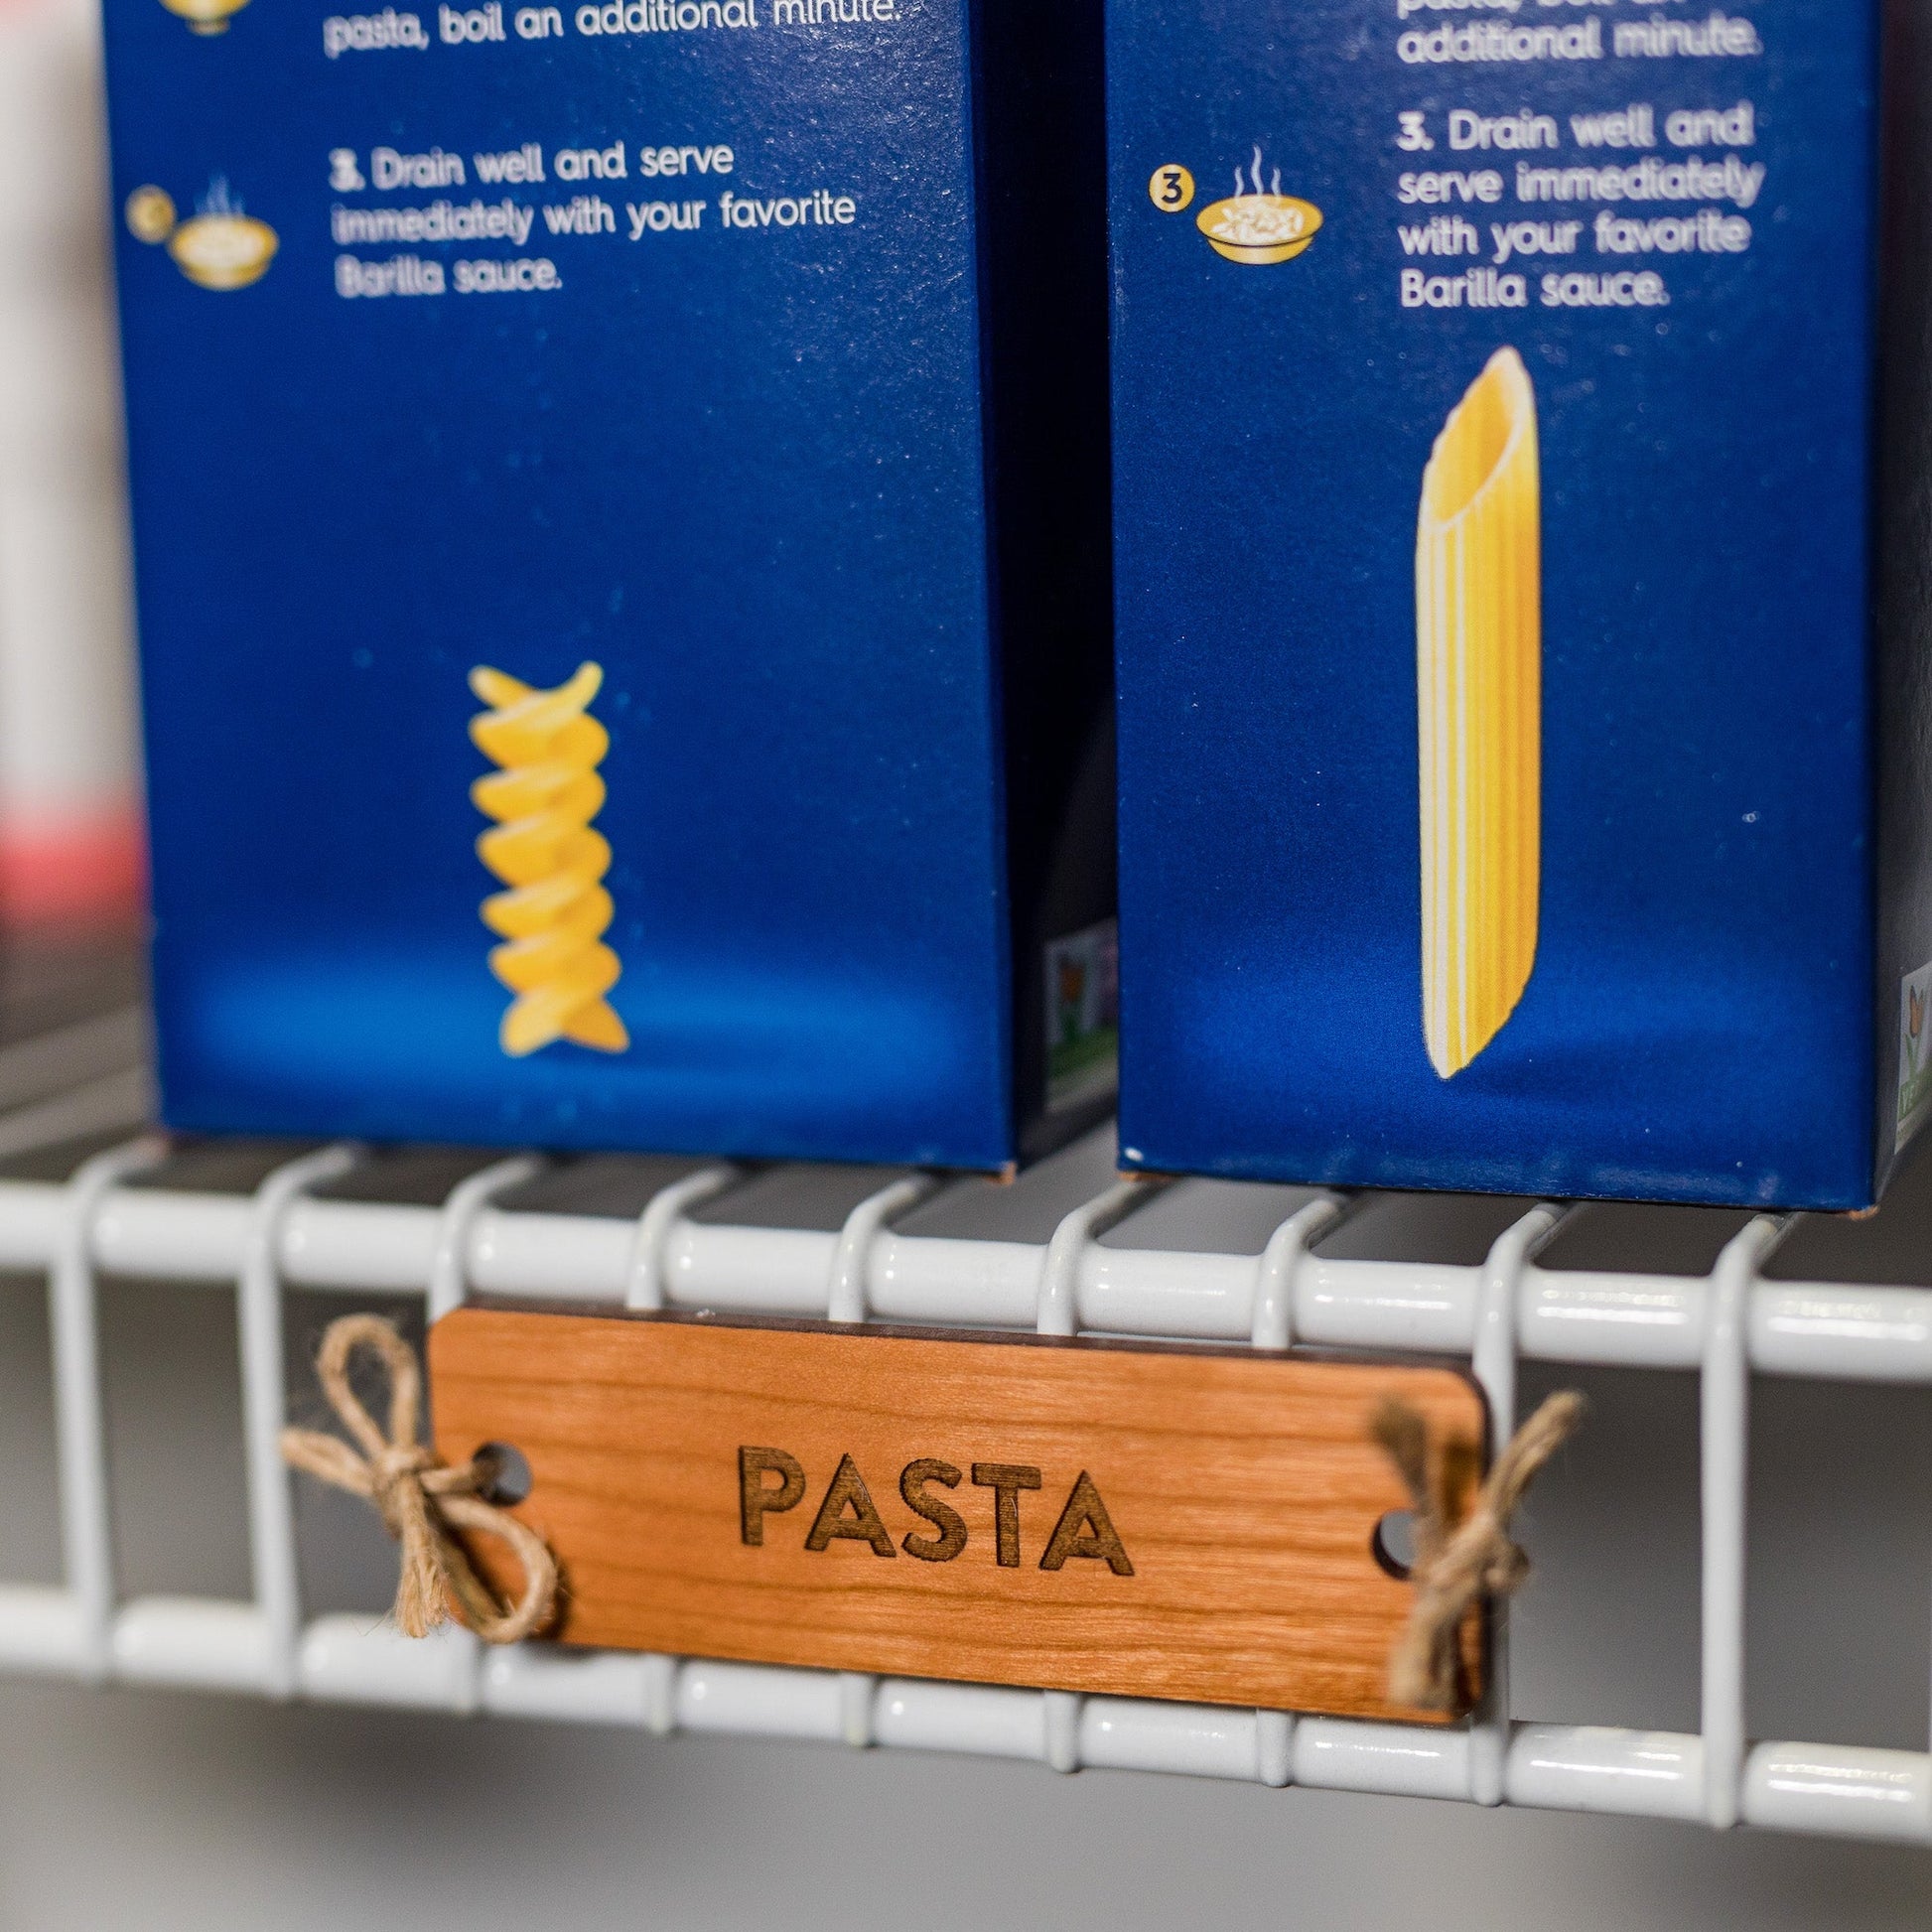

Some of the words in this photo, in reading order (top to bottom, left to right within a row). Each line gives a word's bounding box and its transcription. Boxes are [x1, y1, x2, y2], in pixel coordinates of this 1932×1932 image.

[323, 6, 429, 60] pasta,
[439, 2, 506, 44] boil
[514, 7, 564, 39] an
[575, 0, 758, 36] additional
[774, 0, 901, 25] minute.
[1397, 15, 1603, 64] additional
[1613, 10, 1764, 58] minute.
[1396, 110, 1435, 151] 3.
[1449, 106, 1561, 150] Drain
[1569, 103, 1657, 149] well
[1664, 100, 1755, 147] and
[371, 146, 467, 191] Drain
[474, 142, 545, 184] well
[555, 140, 627, 181] and
[640, 144, 734, 177] serve
[1162, 173, 1182, 204] 3
[1397, 169, 1503, 204] serve
[1515, 152, 1765, 209] immediately
[331, 200, 534, 246] immediately
[543, 196, 617, 235] with
[625, 201, 707, 241] your
[719, 189, 856, 228] favorite
[1397, 214, 1479, 255] with
[1490, 219, 1585, 264] your
[1594, 208, 1752, 252] favorite
[335, 254, 447, 298] Barilla
[453, 257, 563, 293] sauce.
[1400, 266, 1527, 308] Barilla
[1540, 270, 1671, 306] sauce.
[738, 1445, 1135, 1577] PASTA
